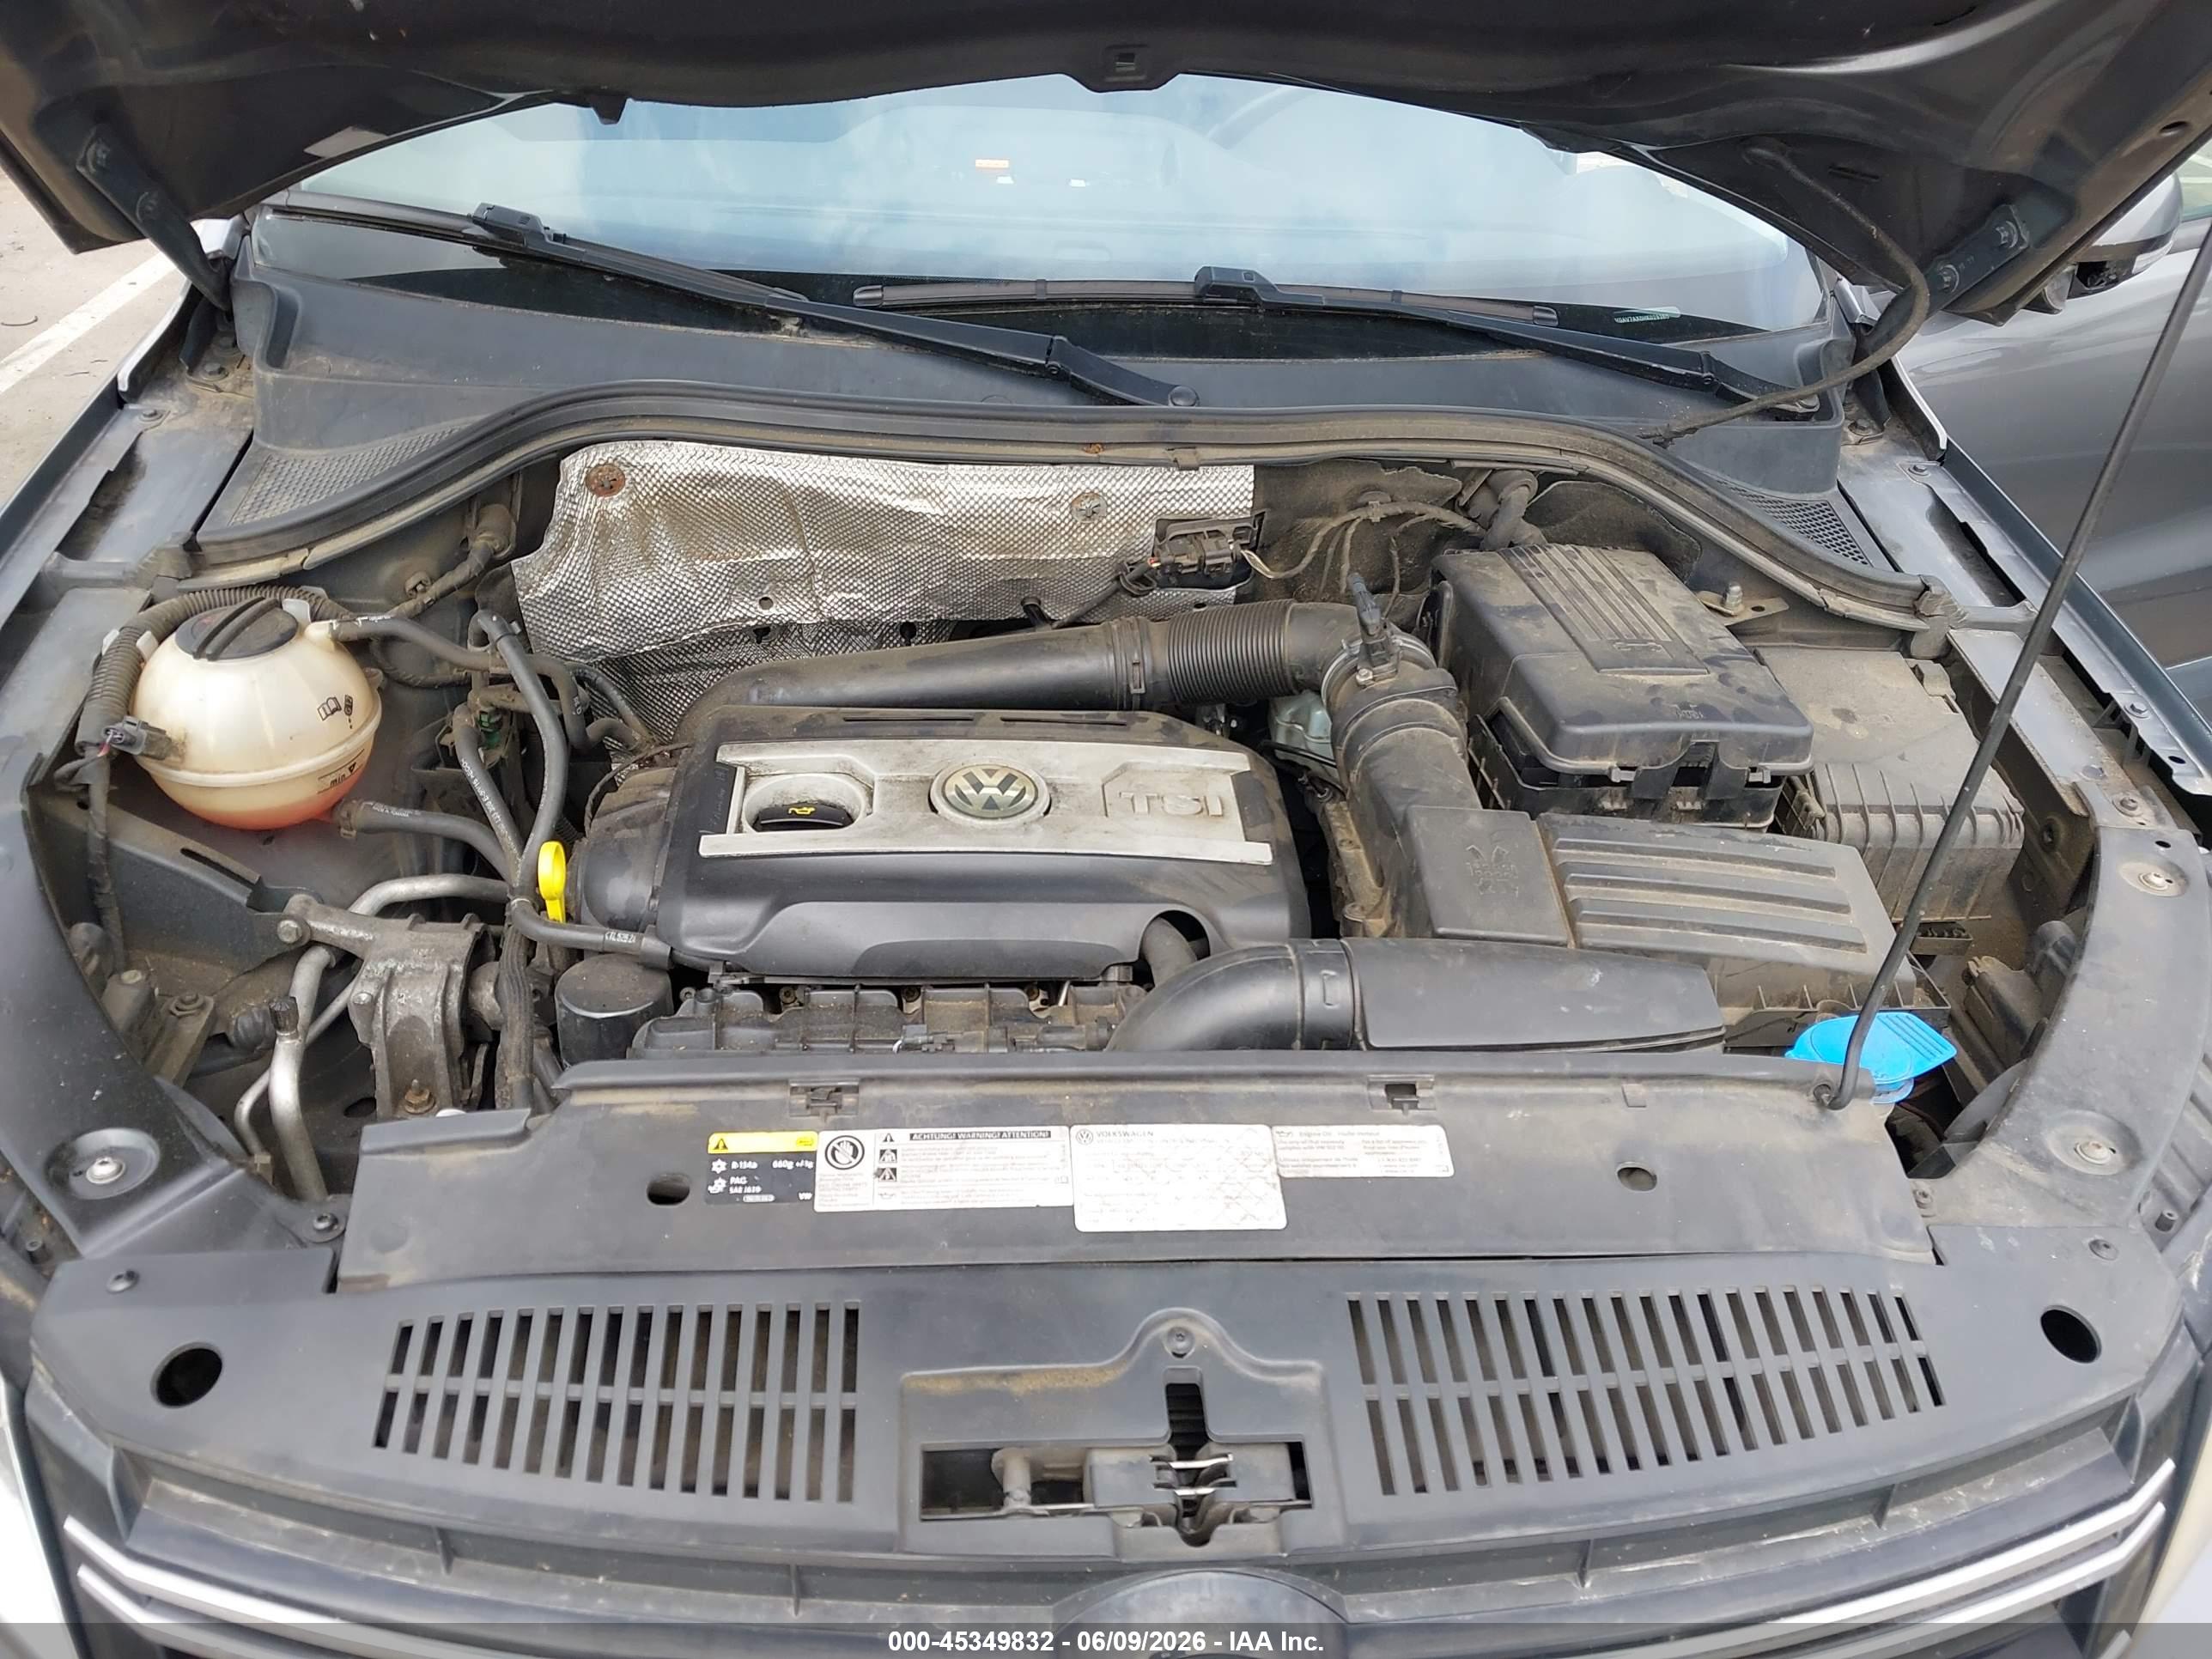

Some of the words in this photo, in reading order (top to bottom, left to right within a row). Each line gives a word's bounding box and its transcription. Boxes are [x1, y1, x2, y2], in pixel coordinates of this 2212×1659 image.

[330, 774, 345, 787] min
[1119, 791, 1223, 817] TSI
[912, 1132, 956, 1140] ACHTUNG!
[957, 1132, 1000, 1140] WARNING!
[1001, 1130, 1049, 1139] ATTENTION!
[730, 1176, 748, 1185] PAG
